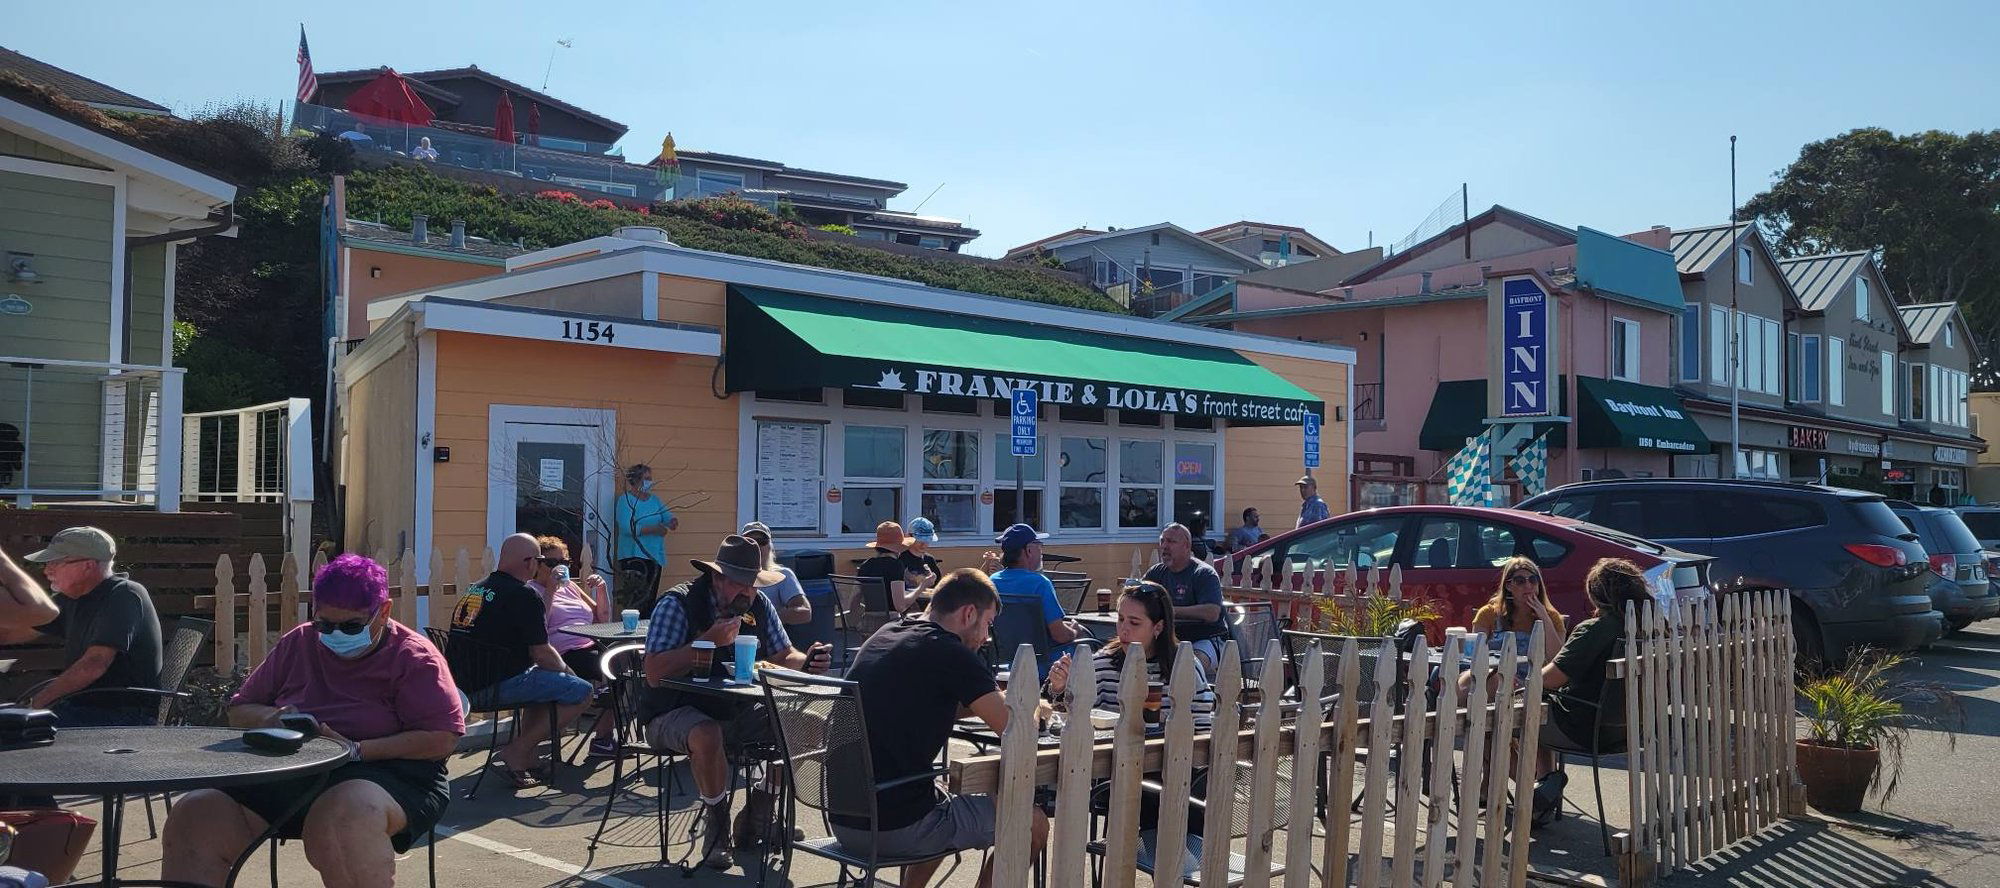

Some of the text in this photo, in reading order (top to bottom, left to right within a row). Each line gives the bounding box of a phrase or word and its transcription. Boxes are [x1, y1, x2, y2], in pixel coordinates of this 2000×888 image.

[1509, 296, 1542, 305] BAYFRONT
[562, 320, 615, 343] 1154
[1510, 310, 1541, 409] INN
[1081, 384, 1098, 405] &
[1106, 386, 1197, 414] LOLA'S
[1203, 394, 1237, 417] front
[1241, 400, 1281, 420] street
[1605, 398, 1683, 420] Bayfront Inn
[1013, 415, 1036, 425] PARKING
[1017, 425, 1031, 436] ONLY
[1793, 427, 1829, 449] BAKERY
[1639, 437, 1695, 451] 1150 Embarcadero
[1177, 460, 1202, 475] OPEN
